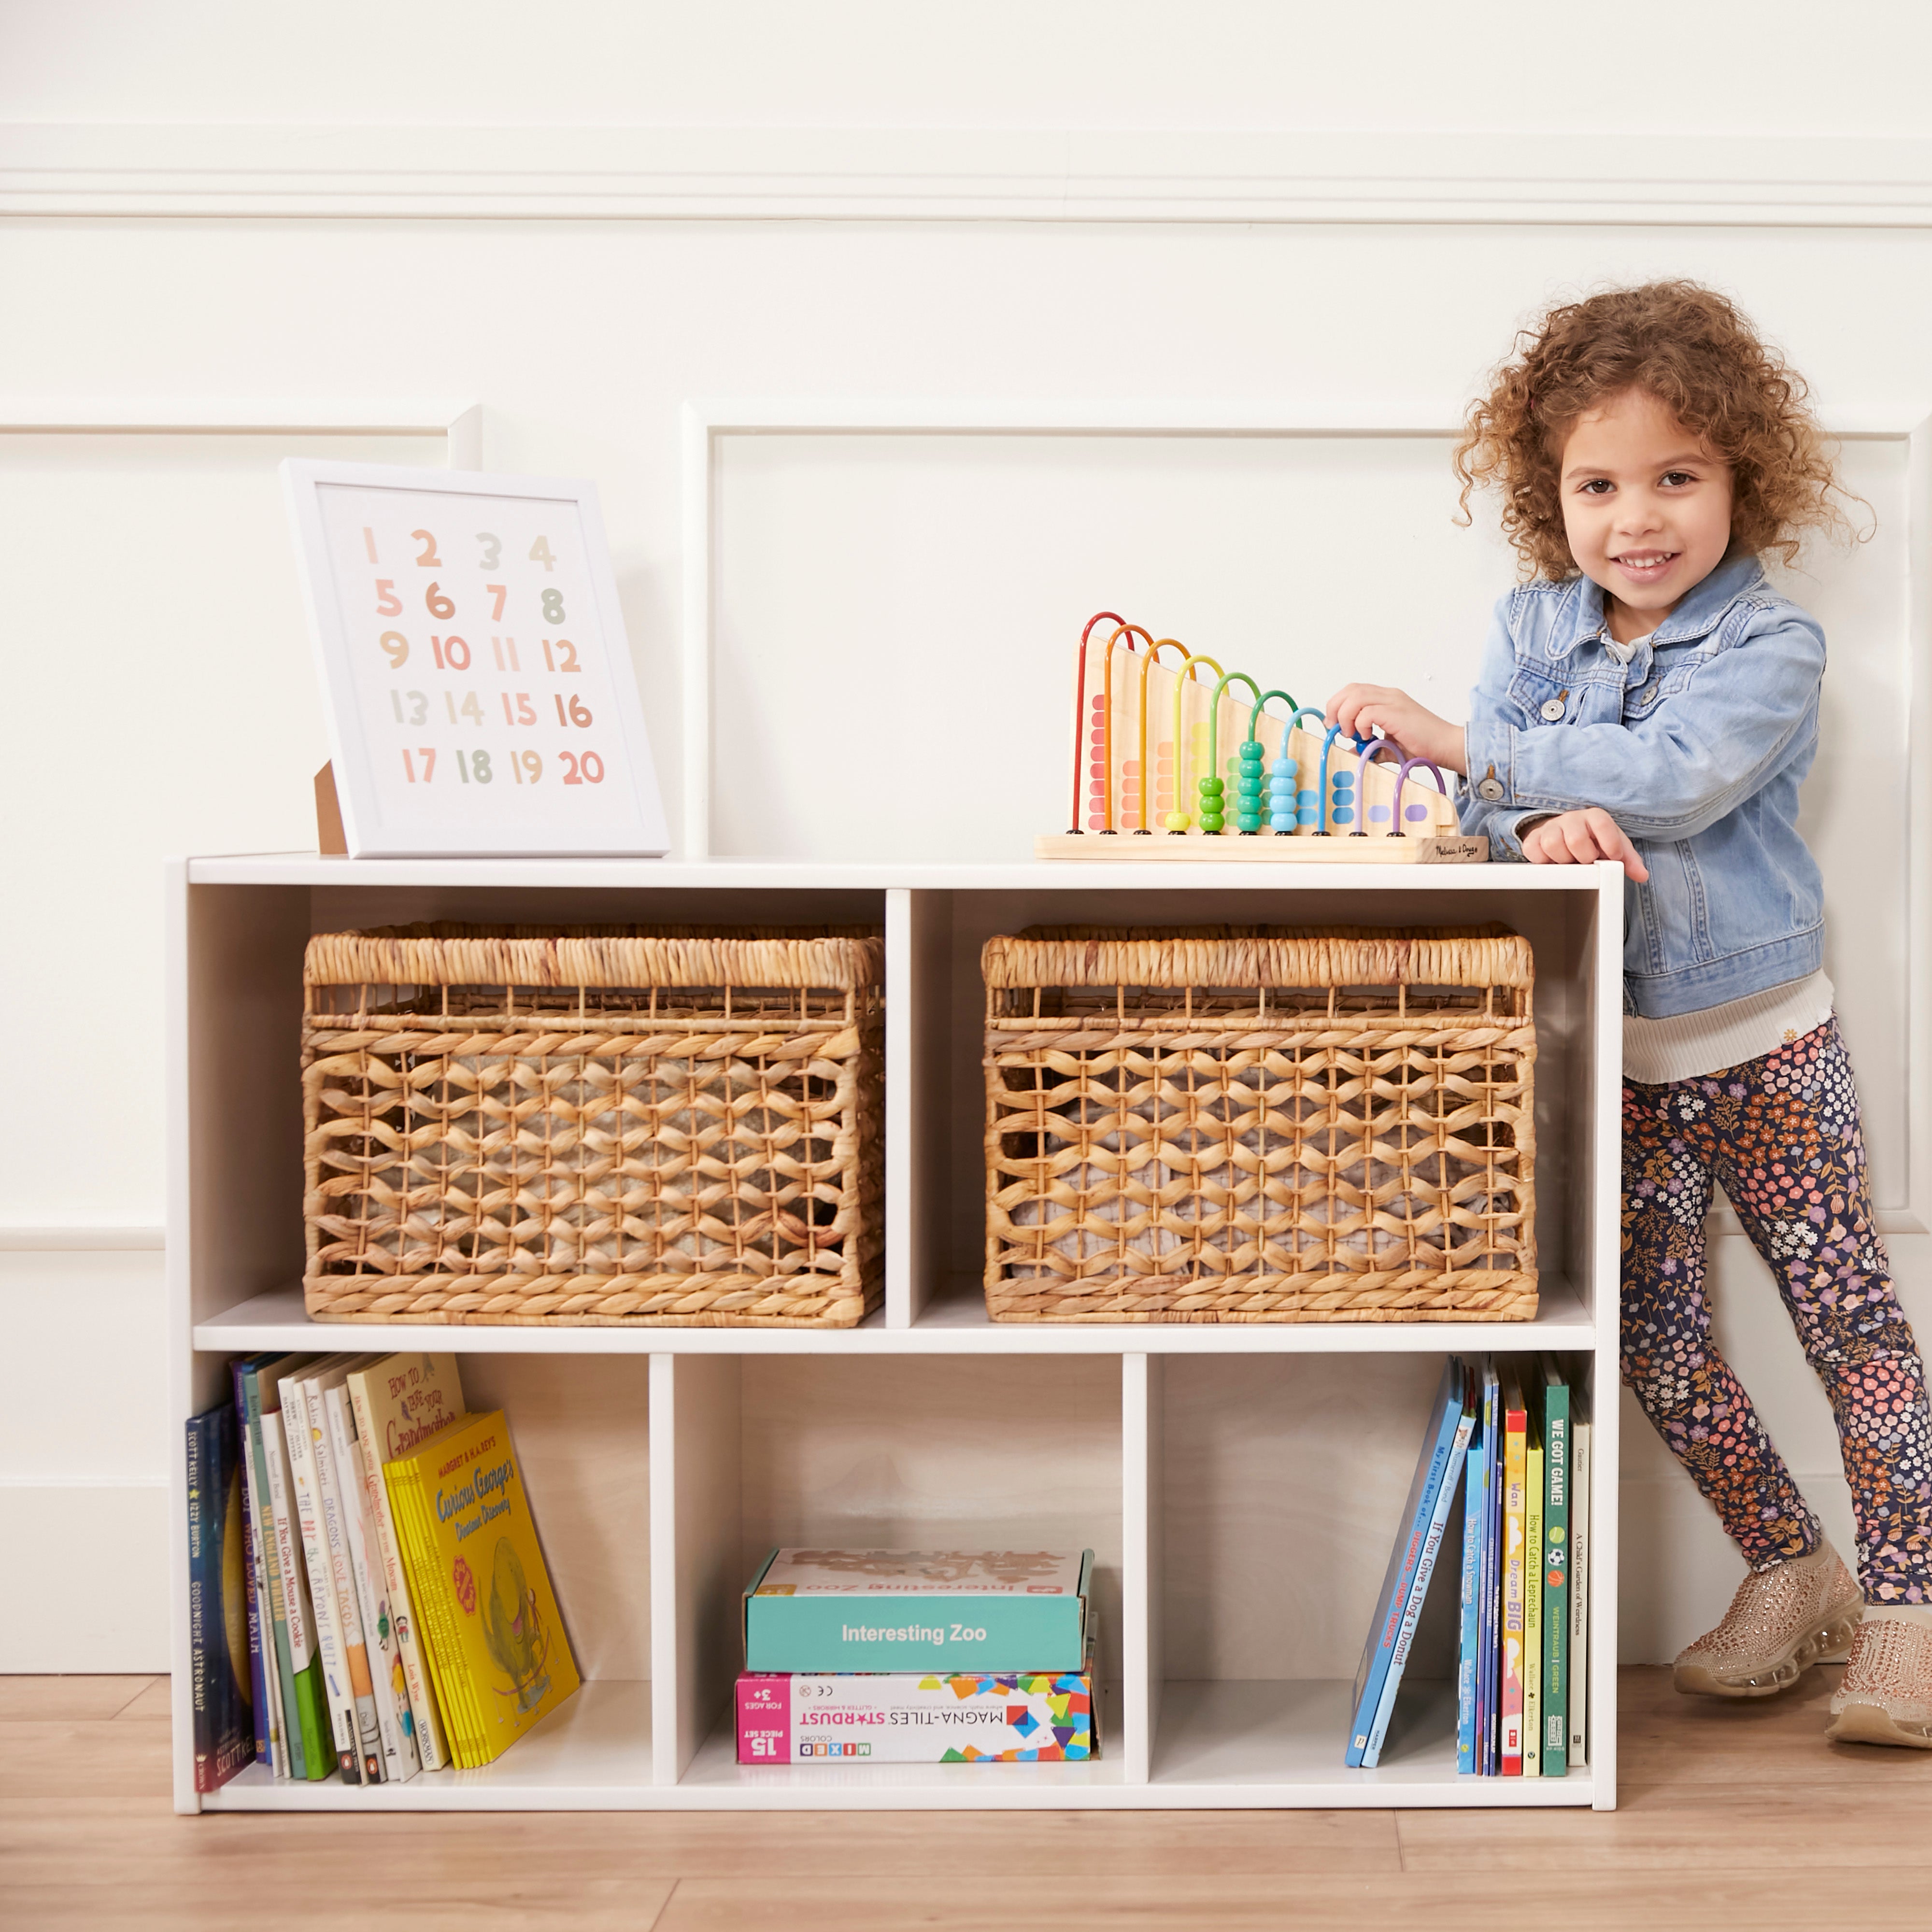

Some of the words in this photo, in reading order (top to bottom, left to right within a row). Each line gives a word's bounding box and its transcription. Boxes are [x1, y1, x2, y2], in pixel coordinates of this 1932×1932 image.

[410, 529, 442, 568] 2
[475, 532, 502, 571] 3
[528, 535, 557, 572] 4
[375, 579, 403, 617] 5
[426, 582, 455, 620] 6
[486, 584, 508, 622] 7
[540, 588, 566, 625] 8
[380, 630, 409, 669] 9
[431, 635, 471, 671] 10
[491, 637, 521, 671] 11
[541, 639, 582, 673] 12
[390, 689, 429, 726] 13
[444, 690, 485, 726] 14
[501, 692, 537, 726] 15
[554, 693, 593, 728] 16
[402, 748, 437, 783] 17
[456, 749, 493, 784] 18
[511, 750, 543, 784] 19
[558, 751, 605, 785] 20
[1436, 845, 1457, 857] Melissa
[388, 1374, 406, 1400] HOW
[408, 1367, 419, 1386] TO
[283, 1396, 291, 1427] DAYWALT
[408, 1389, 424, 1412] TAKE
[425, 1390, 443, 1412] YOUR
[359, 1418, 365, 1427] TO
[1551, 1419, 1564, 1439] WE
[188, 1431, 198, 1458] SCOTT
[307, 1395, 317, 1424] Rubin
[315, 1444, 328, 1486] Salmieri
[361, 1430, 369, 1447] TAKE
[1435, 1446, 1445, 1459] My
[1551, 1440, 1564, 1465] GOT
[188, 1460, 199, 1486] KELLY
[269, 1450, 279, 1478] Numeroff
[438, 1454, 464, 1479] MARGRET
[464, 1451, 469, 1463] &
[1430, 1460, 1441, 1481] First
[1447, 1451, 1461, 1482] Numeroff
[368, 1474, 385, 1527] Grandmother
[436, 1485, 475, 1523] Curious
[473, 1459, 514, 1499] George's
[1423, 1484, 1435, 1504] Book
[1441, 1486, 1451, 1503] Bond
[1511, 1483, 1521, 1506] Wan
[1551, 1467, 1563, 1506] GAME!
[190, 1502, 200, 1523] IZZY
[261, 1505, 274, 1527] NEW
[298, 1492, 313, 1514] THE
[277, 1518, 287, 1526] If
[301, 1520, 316, 1541] DAY
[324, 1498, 341, 1548] DRAGONS
[455, 1516, 482, 1542] Dinosaur
[481, 1498, 511, 1524] Discovery
[1432, 1521, 1444, 1533] If
[1467, 1519, 1477, 1534] How
[1529, 1515, 1540, 1533] How
[190, 1524, 200, 1558] BURTON
[244, 1523, 254, 1555] WHO
[279, 1527, 288, 1545] You
[1425, 1534, 1441, 1554] You
[1529, 1535, 1536, 1544] to
[264, 1530, 280, 1577] ENGLAND
[282, 1547, 291, 1568] Give
[1404, 1531, 1422, 1572] DIGGERS
[1466, 1544, 1477, 1564] Catch
[1528, 1546, 1539, 1570] Catch
[333, 1554, 346, 1582] LOVE
[1418, 1558, 1433, 1582] Give
[1510, 1559, 1520, 1599] Dream
[245, 1562, 256, 1605] LOVED
[286, 1577, 296, 1607] Mouse
[310, 1567, 331, 1628] CRAYONS
[868, 1584, 1014, 1592] Interesting
[1394, 1582, 1408, 1609] DUMP
[1465, 1570, 1476, 1605] Snowman
[270, 1579, 286, 1621] WHALER
[339, 1588, 355, 1628] TACOS
[1405, 1595, 1422, 1618] Dog
[1528, 1579, 1538, 1628] Leprechaun
[1383, 1611, 1400, 1648] TRUCKS
[1507, 1601, 1521, 1631] BIG
[248, 1611, 259, 1653] MATH
[291, 1617, 302, 1648] Cookie
[842, 1624, 944, 1645] Interesting
[949, 1624, 987, 1641] Zoo
[321, 1635, 337, 1666] QUIT
[1393, 1631, 1412, 1666] Donut
[193, 1648, 205, 1712] ASTRONAUT
[1463, 1659, 1472, 1684] Wallace
[411, 1681, 420, 1702] Wyse
[754, 1689, 771, 1701] 3+
[890, 1712, 1003, 1725] MAGNA-TILES
[1463, 1697, 1472, 1725] Elkerton
[419, 1720, 433, 1762] WORKMAN
[751, 1737, 777, 1756] 15
[801, 1744, 870, 1756] MIXED
[217, 1743, 241, 1777] SCOTT
